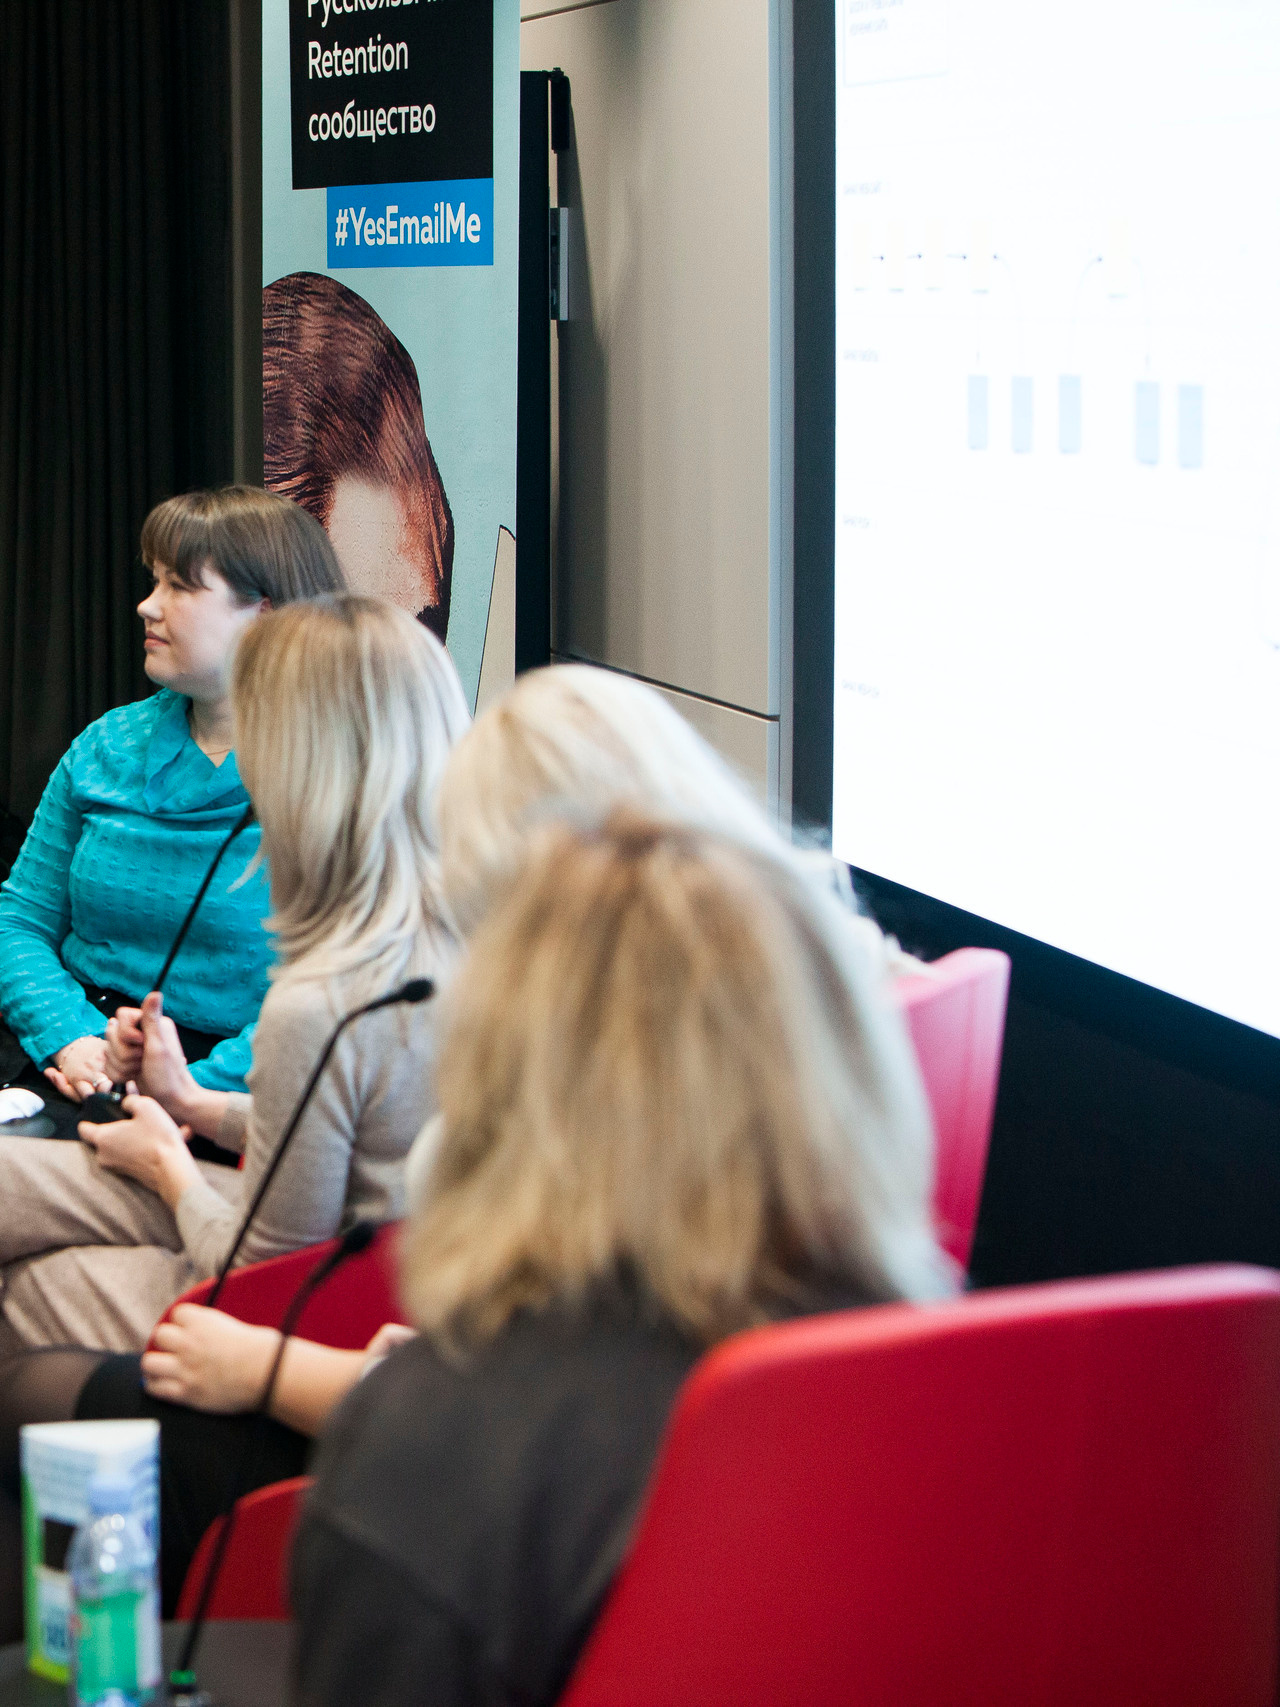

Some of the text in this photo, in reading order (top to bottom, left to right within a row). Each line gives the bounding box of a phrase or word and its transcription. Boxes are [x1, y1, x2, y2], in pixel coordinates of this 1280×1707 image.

[308, 34, 409, 80] Retention
[308, 99, 437, 143] сообщество
[335, 201, 482, 247] #YesEmailMe
